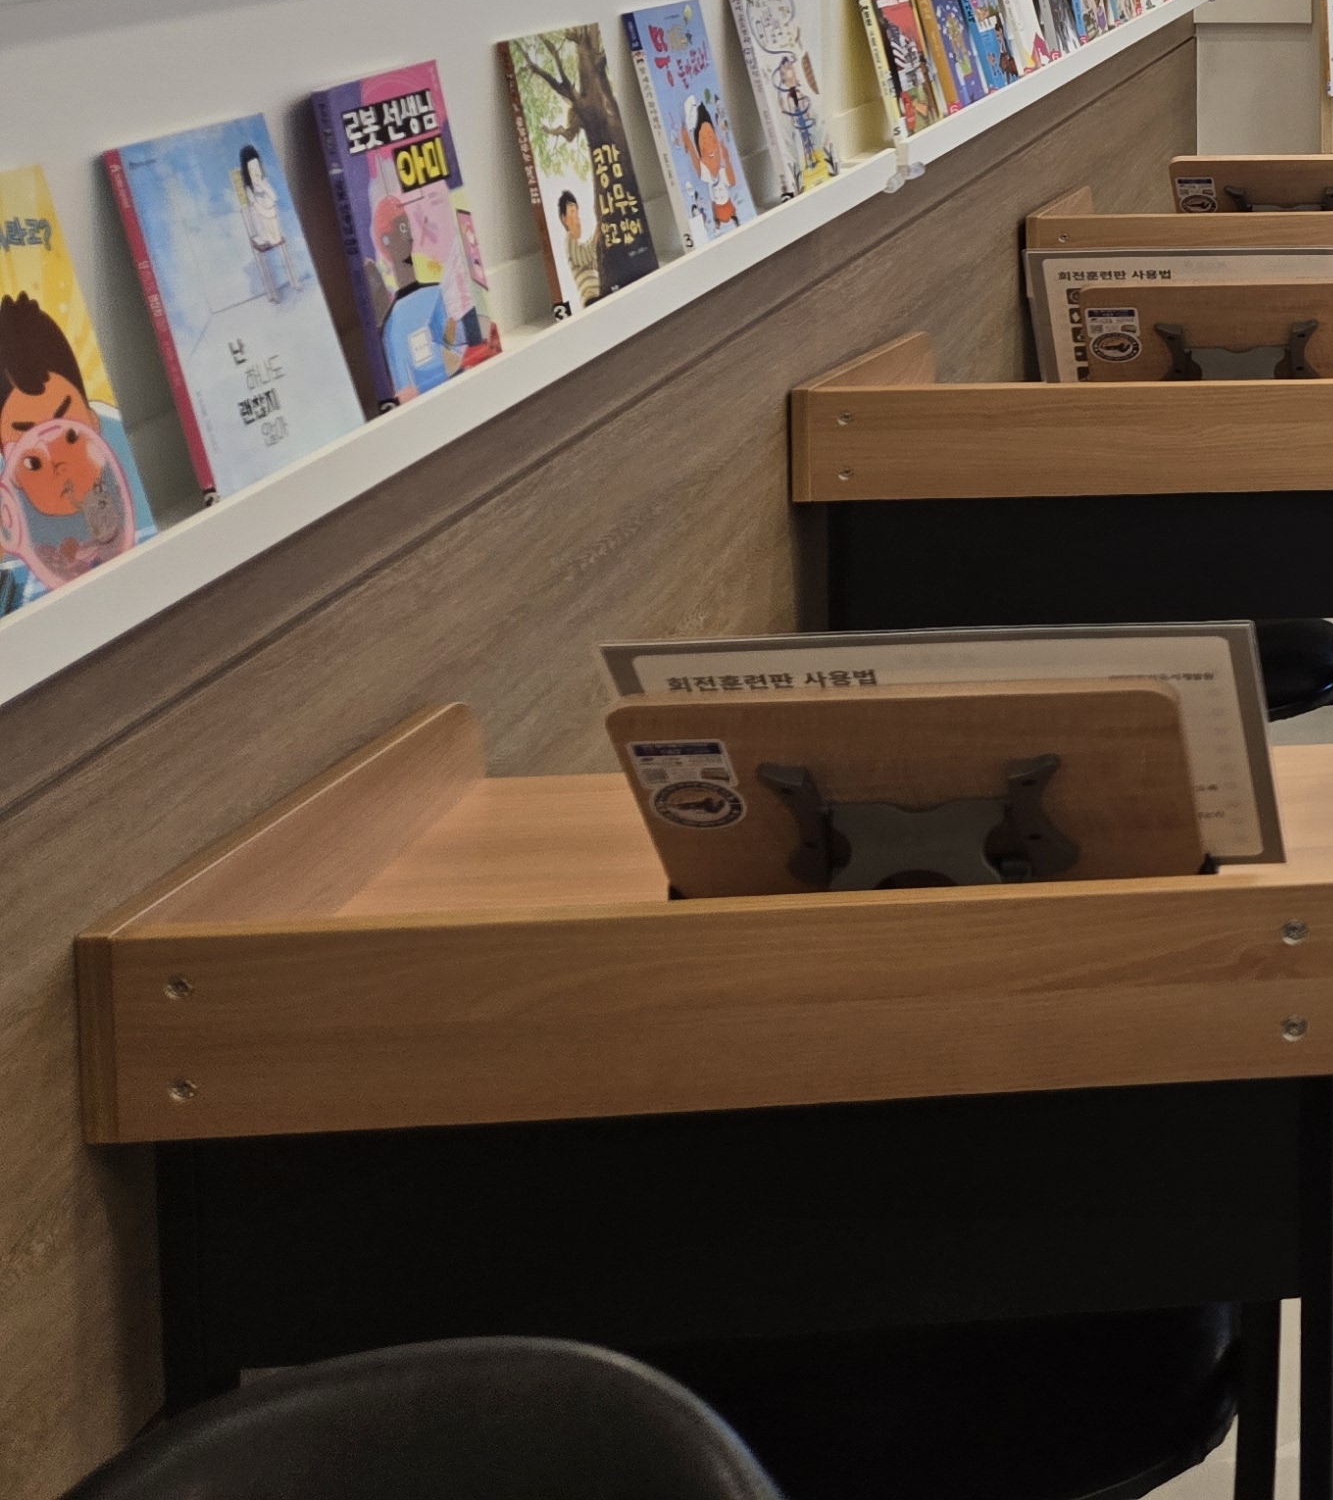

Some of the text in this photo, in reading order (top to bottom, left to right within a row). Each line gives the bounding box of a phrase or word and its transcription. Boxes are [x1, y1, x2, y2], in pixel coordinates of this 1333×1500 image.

[343, 90, 438, 154] 로봇 선생님
[396, 137, 449, 186] 아미
[1132, 269, 1172, 280] 사용법
[553, 303, 571, 323] 3
[228, 338, 247, 366] 난
[237, 387, 280, 426] 괜찮지
[667, 669, 877, 693] 회전훈련판 사용법
